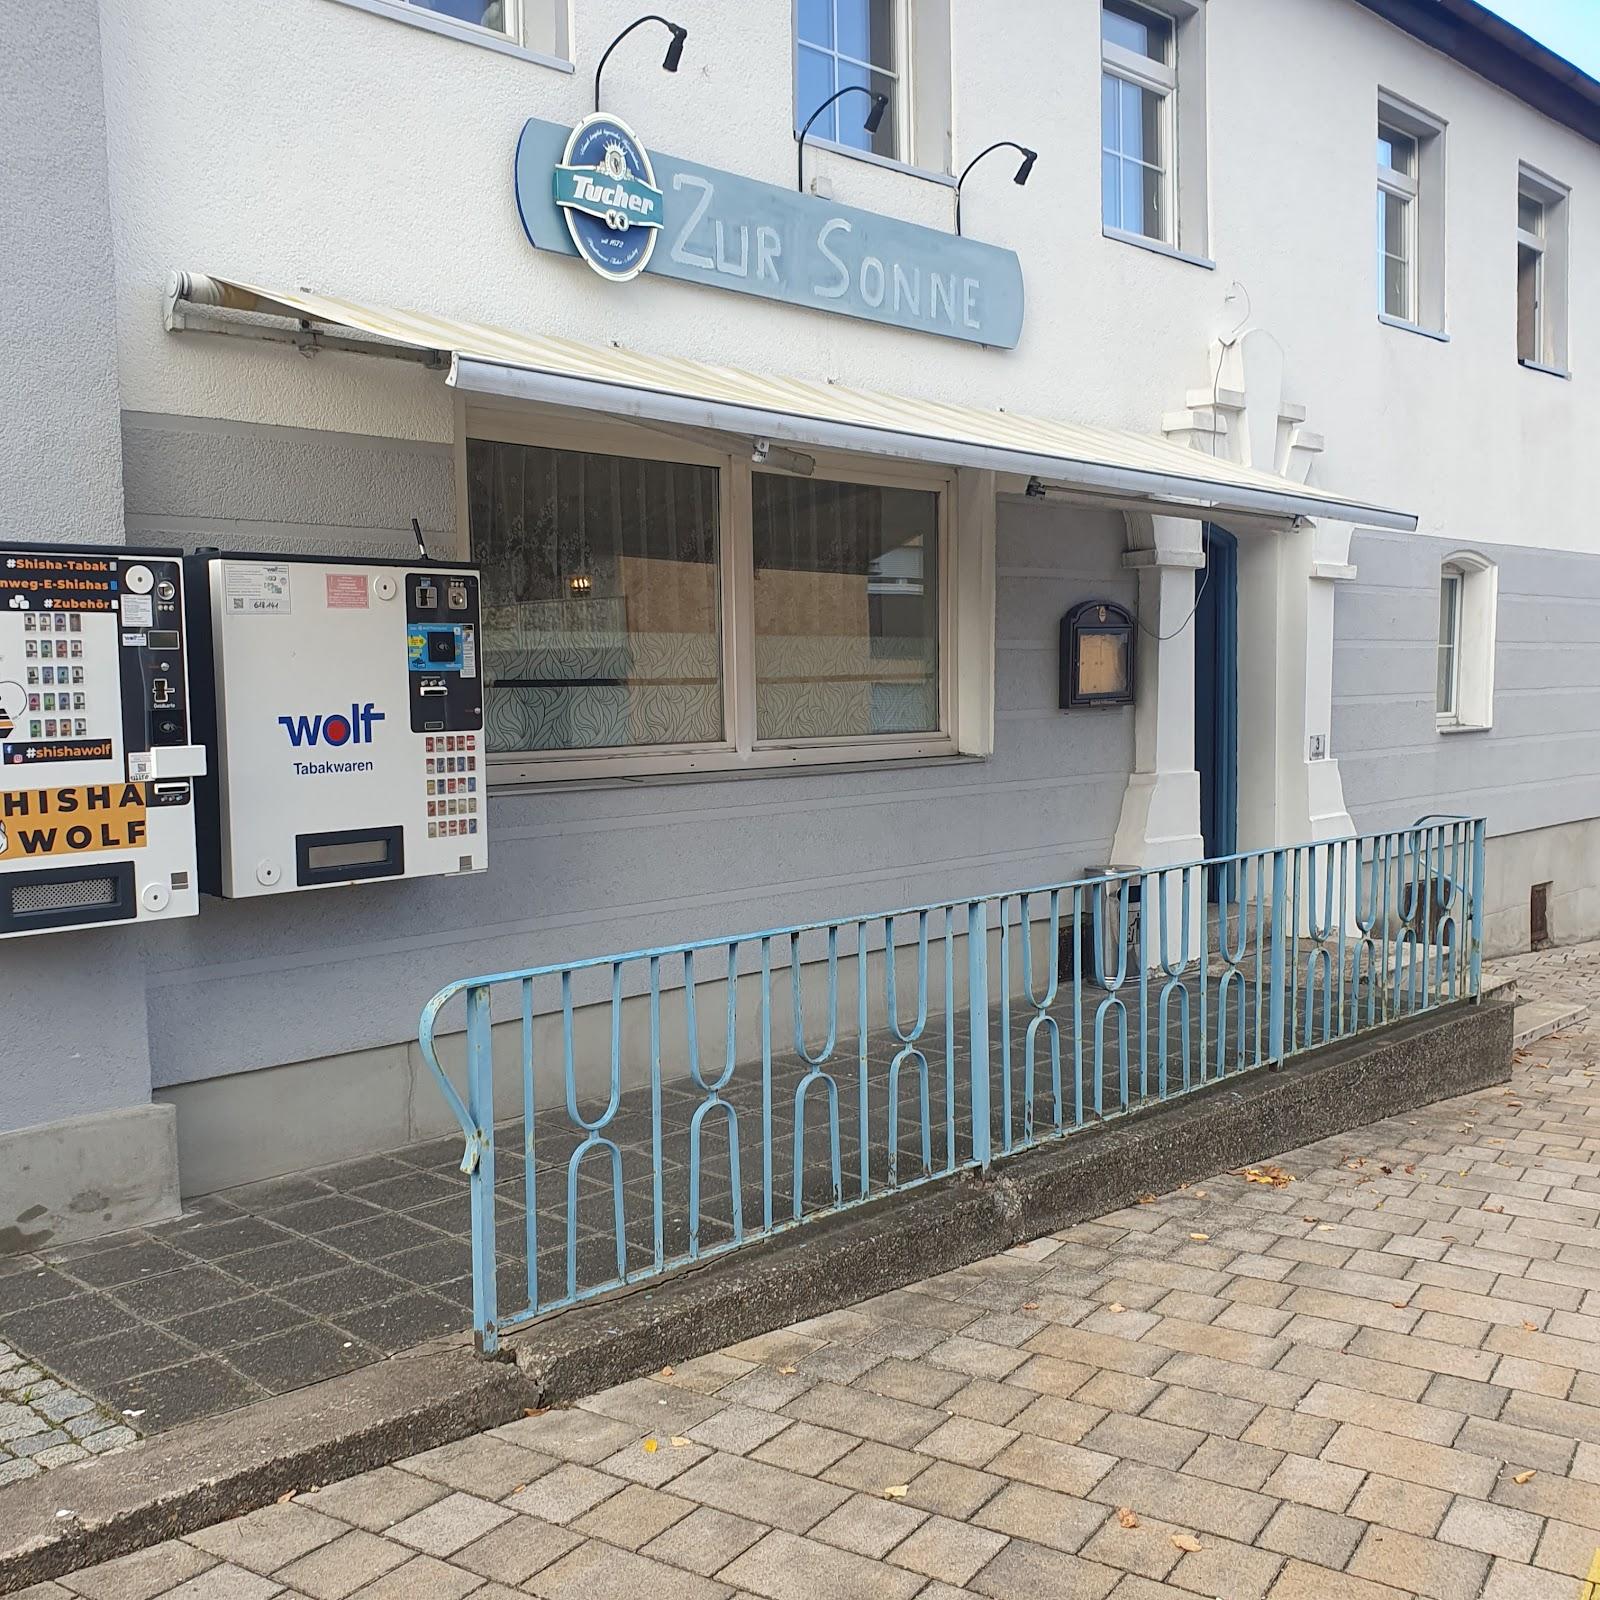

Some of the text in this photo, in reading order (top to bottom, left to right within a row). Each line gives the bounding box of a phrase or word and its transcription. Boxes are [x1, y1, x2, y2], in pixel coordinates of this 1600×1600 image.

[573, 174, 654, 215] Tucher
[6, 558, 108, 572] #Shisha-Tabak
[0, 579, 109, 591] nweg-E-Shishas
[43, 598, 110, 610] #Zubehör
[278, 703, 385, 746] wolf
[1315, 736, 1320, 750] 3
[26, 743, 112, 759] #shishawolf
[293, 761, 374, 775] Tabakwaren
[17, 820, 146, 854] WOLF
